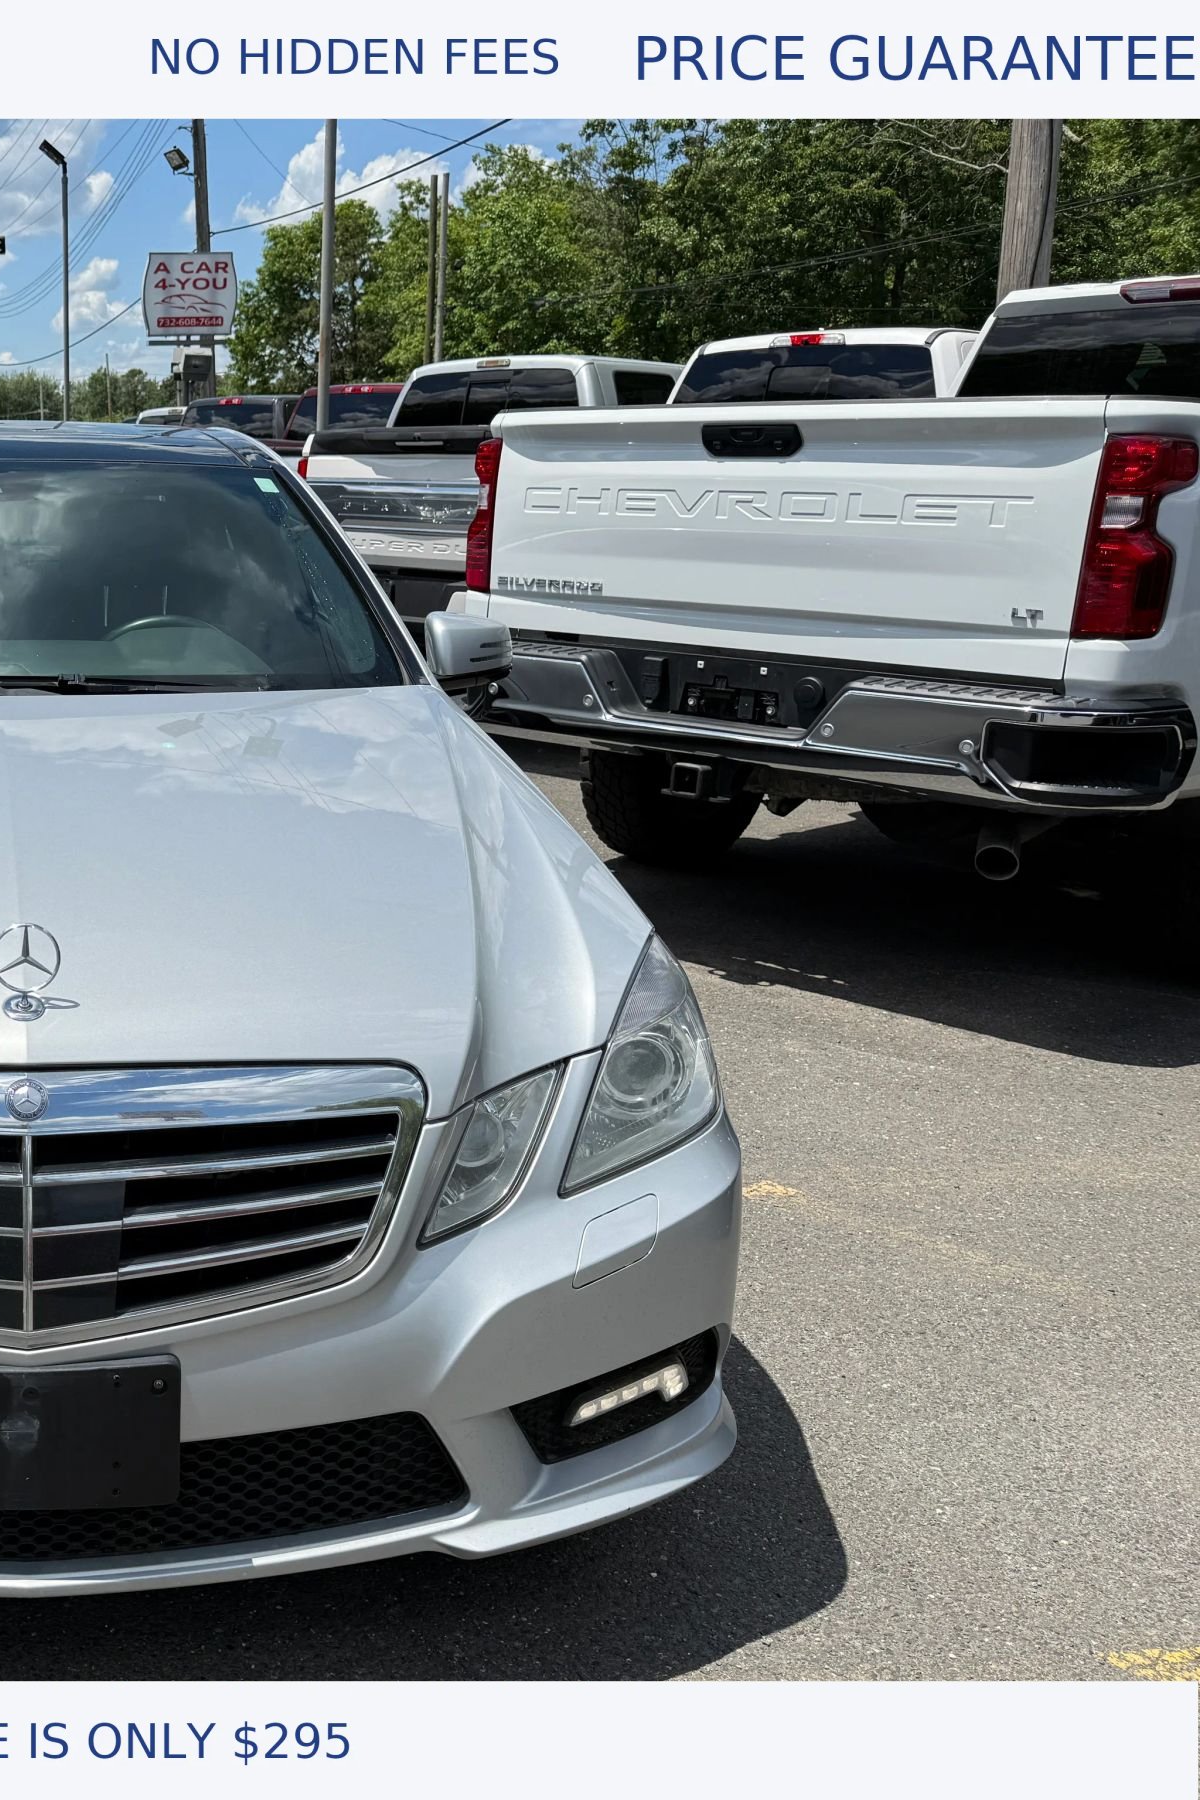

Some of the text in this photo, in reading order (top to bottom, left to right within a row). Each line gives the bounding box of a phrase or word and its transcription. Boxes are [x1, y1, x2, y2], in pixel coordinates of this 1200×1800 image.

[153, 260, 230, 275] A CAR
[153, 277, 228, 291] 4-YOU
[523, 486, 1036, 529] CHEVROLET
[351, 538, 425, 553] UPER
[497, 575, 603, 592] SILVERADO
[1010, 606, 1044, 621] LT
